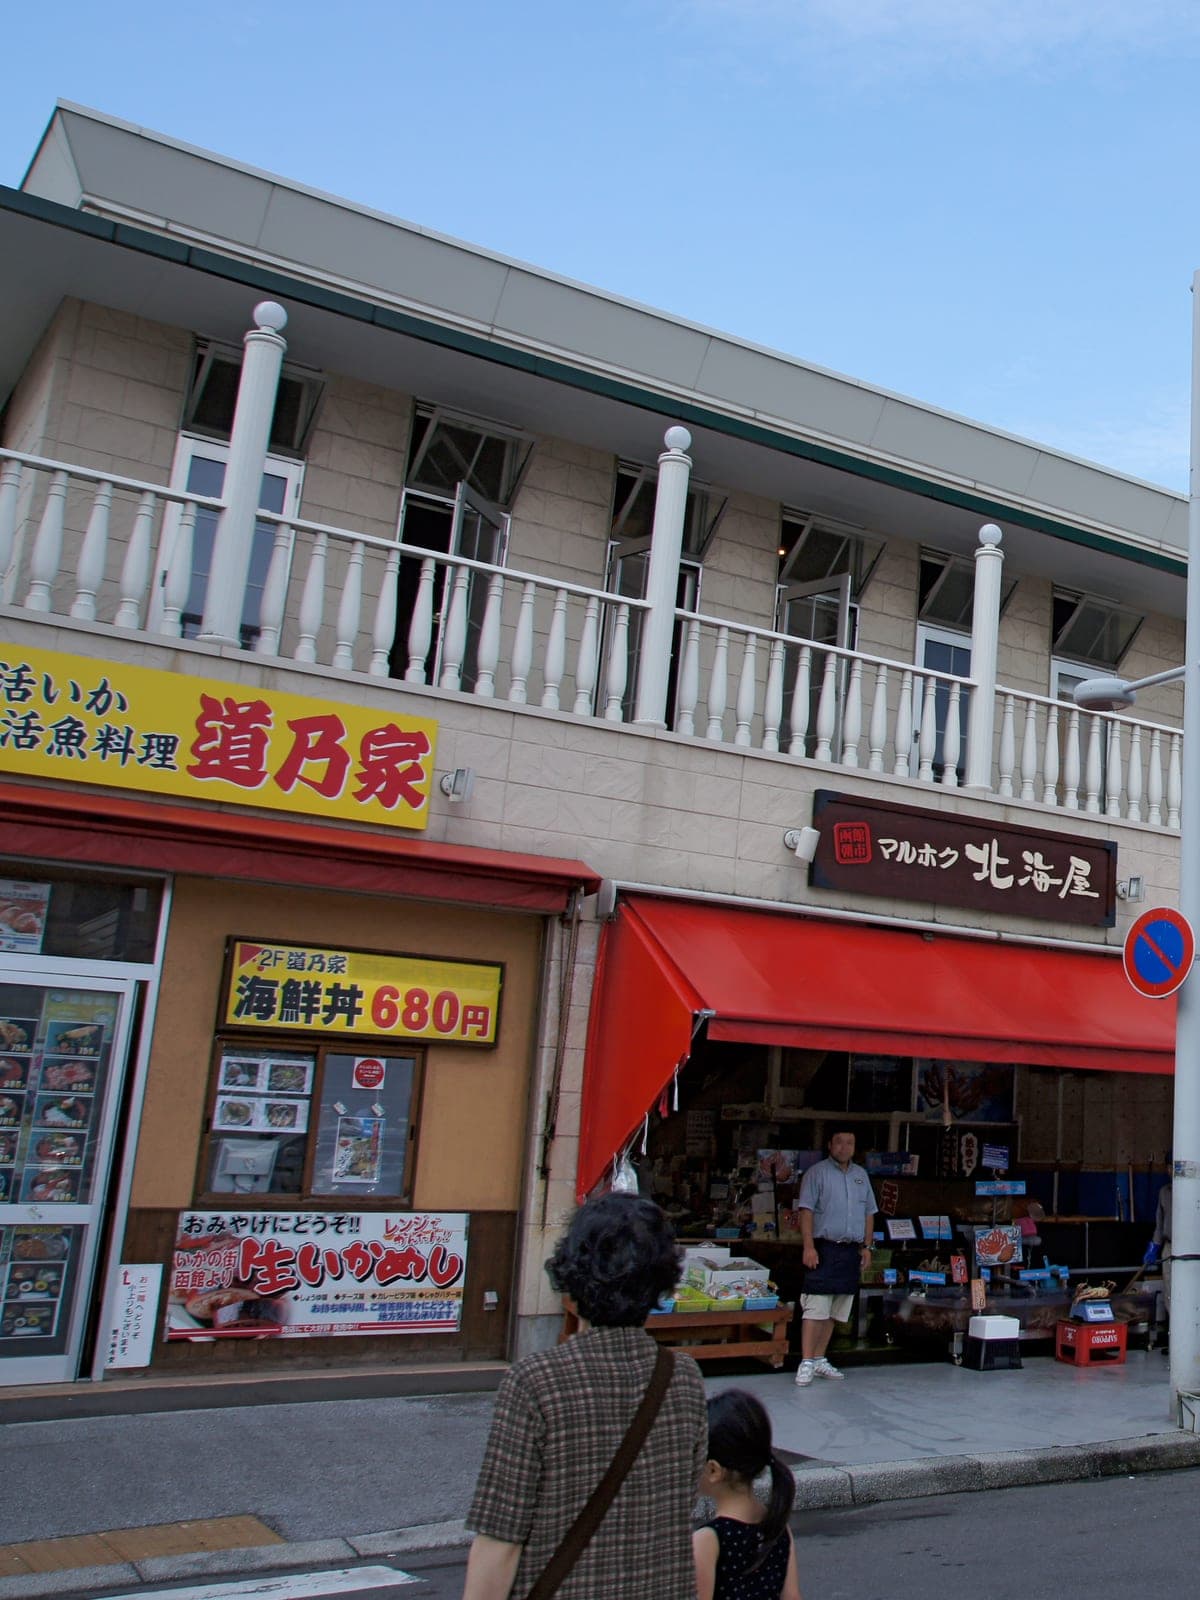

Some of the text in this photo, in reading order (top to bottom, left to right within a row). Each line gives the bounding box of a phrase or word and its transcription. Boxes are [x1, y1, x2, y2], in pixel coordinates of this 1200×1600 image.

[0, 662, 128, 716] 活いか
[0, 709, 180, 770] 活魚料理
[186, 693, 431, 811] 道乃家
[877, 838, 1100, 899] マルホク 北海屋
[259, 949, 347, 974] 2F 道乃家
[234, 975, 490, 1038] 海鮮丼 680円
[183, 1215, 361, 1235] おみやげにどうぞ!!
[174, 1250, 237, 1269] いかの街
[174, 1270, 233, 1289] 函館より
[239, 1236, 464, 1297] 生いかめし
